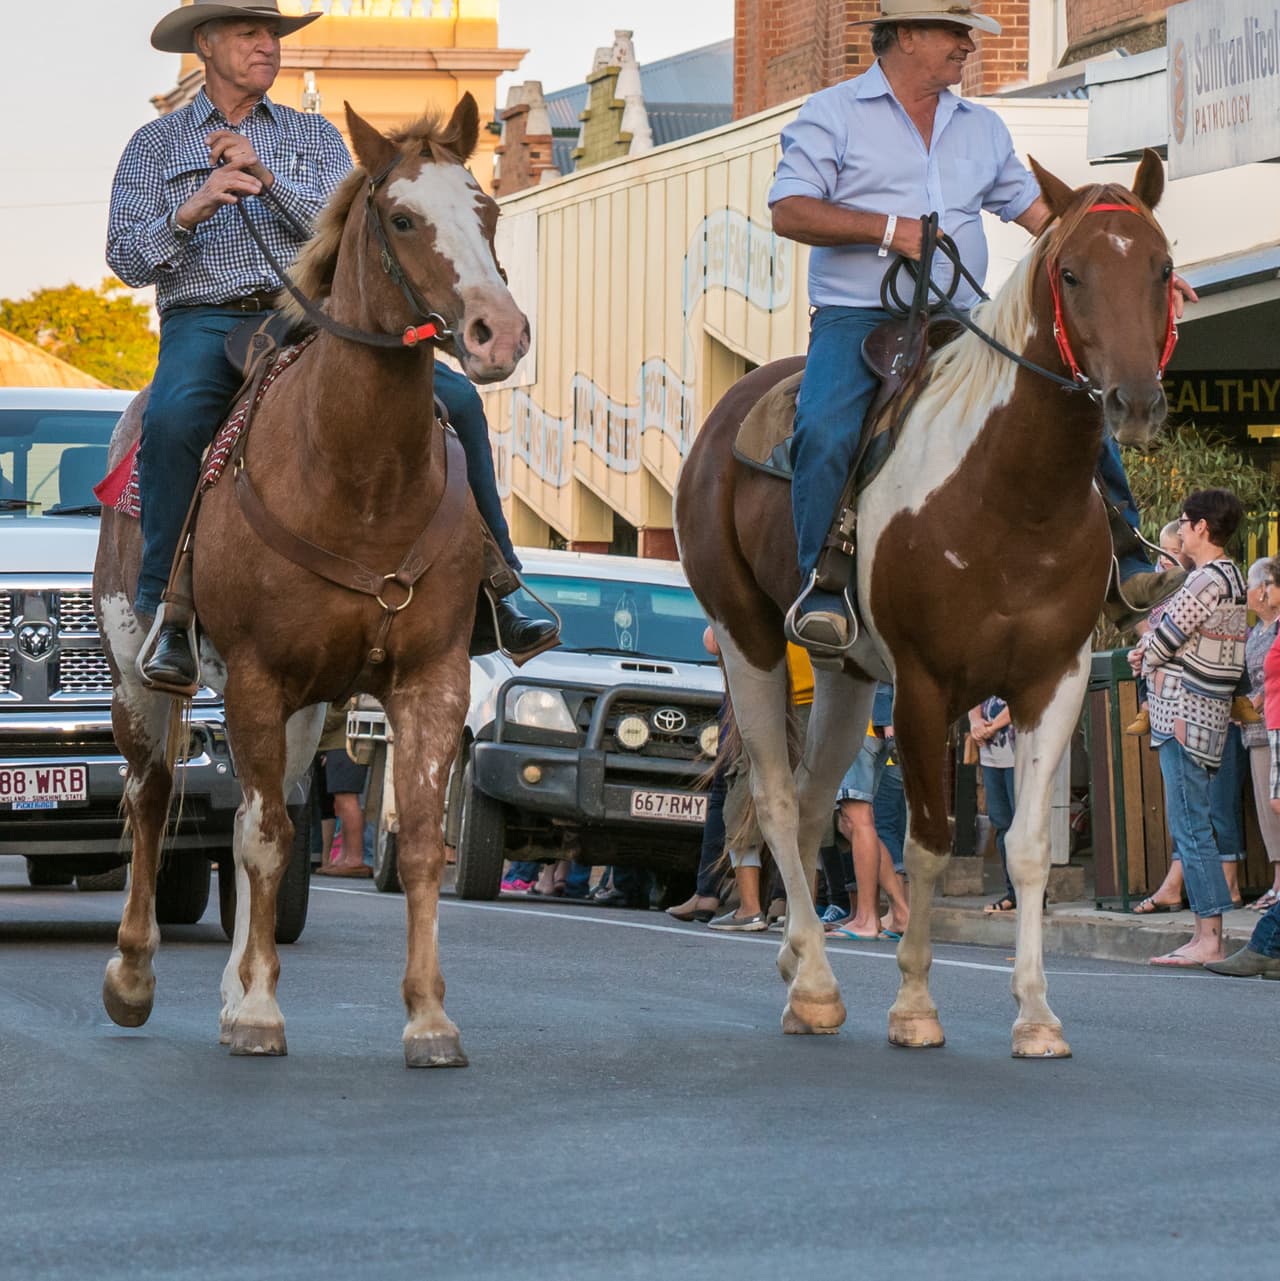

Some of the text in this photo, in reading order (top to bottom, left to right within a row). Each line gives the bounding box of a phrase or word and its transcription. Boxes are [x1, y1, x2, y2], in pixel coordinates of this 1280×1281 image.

[1194, 28, 1243, 96] Sullivan
[1195, 95, 1251, 136] PATHOLOGY
[1163, 378, 1280, 414] EALTHY
